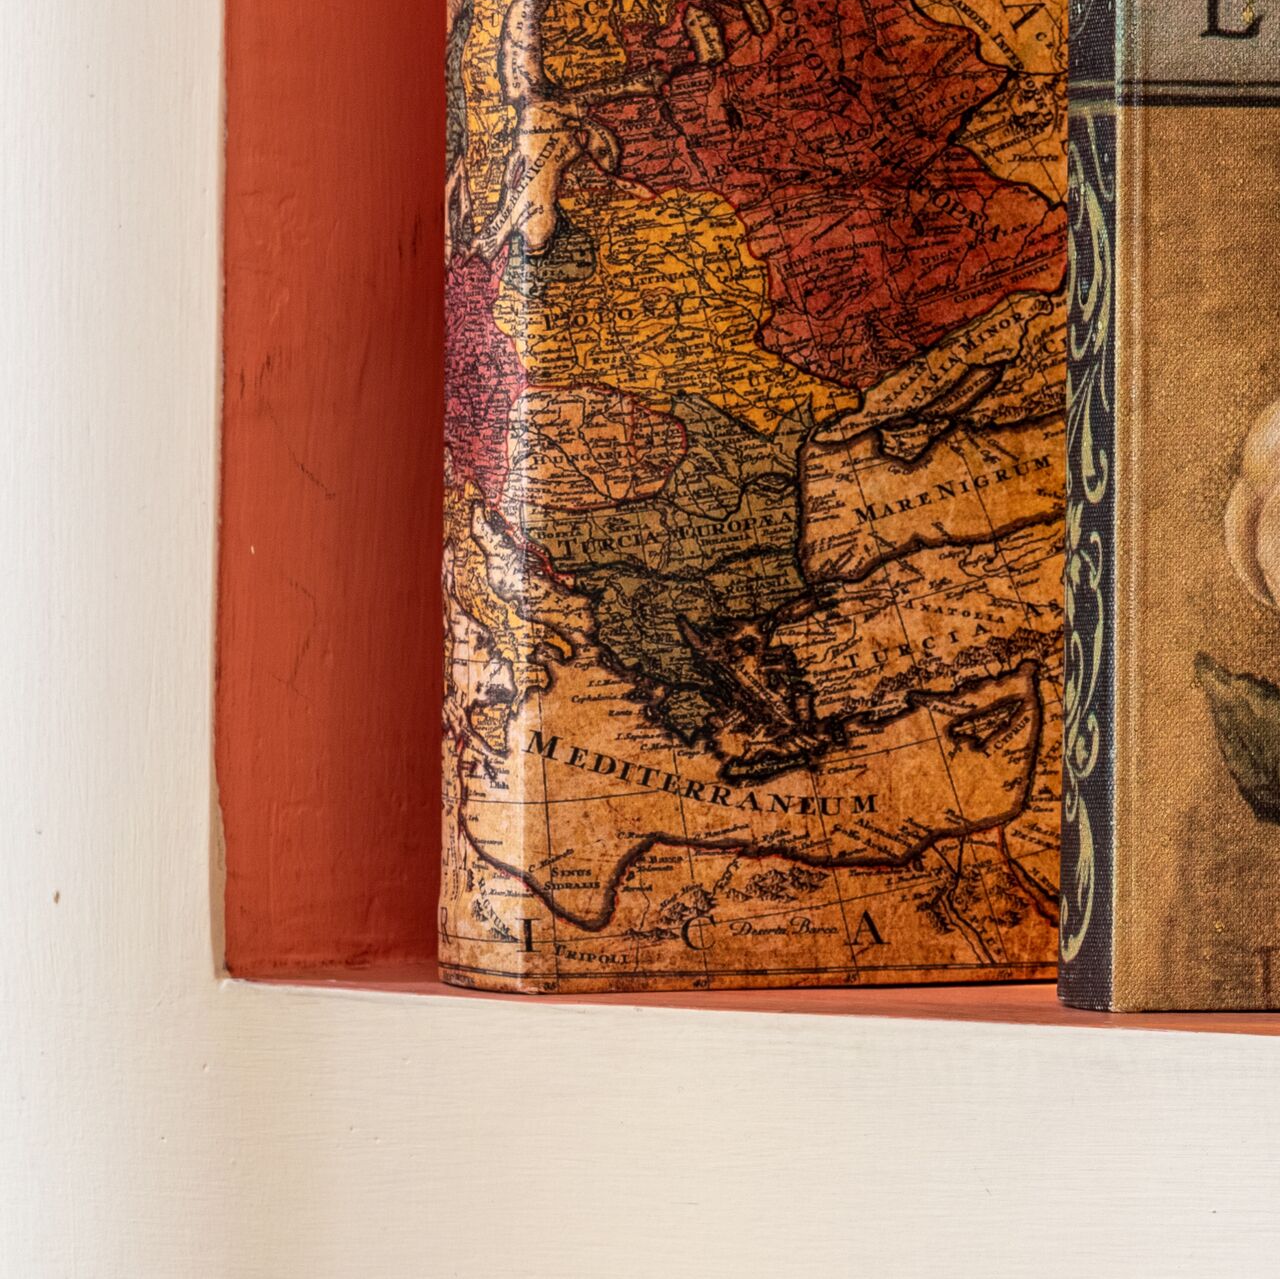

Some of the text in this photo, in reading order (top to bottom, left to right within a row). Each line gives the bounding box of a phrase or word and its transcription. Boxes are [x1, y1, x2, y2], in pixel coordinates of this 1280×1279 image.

[854, 492, 932, 524] MARE
[934, 454, 1053, 500] NIGRUM
[522, 729, 879, 817] MEDITERRANEUM
[551, 867, 593, 878] SINUS
[555, 943, 633, 965] TRIPOLI
